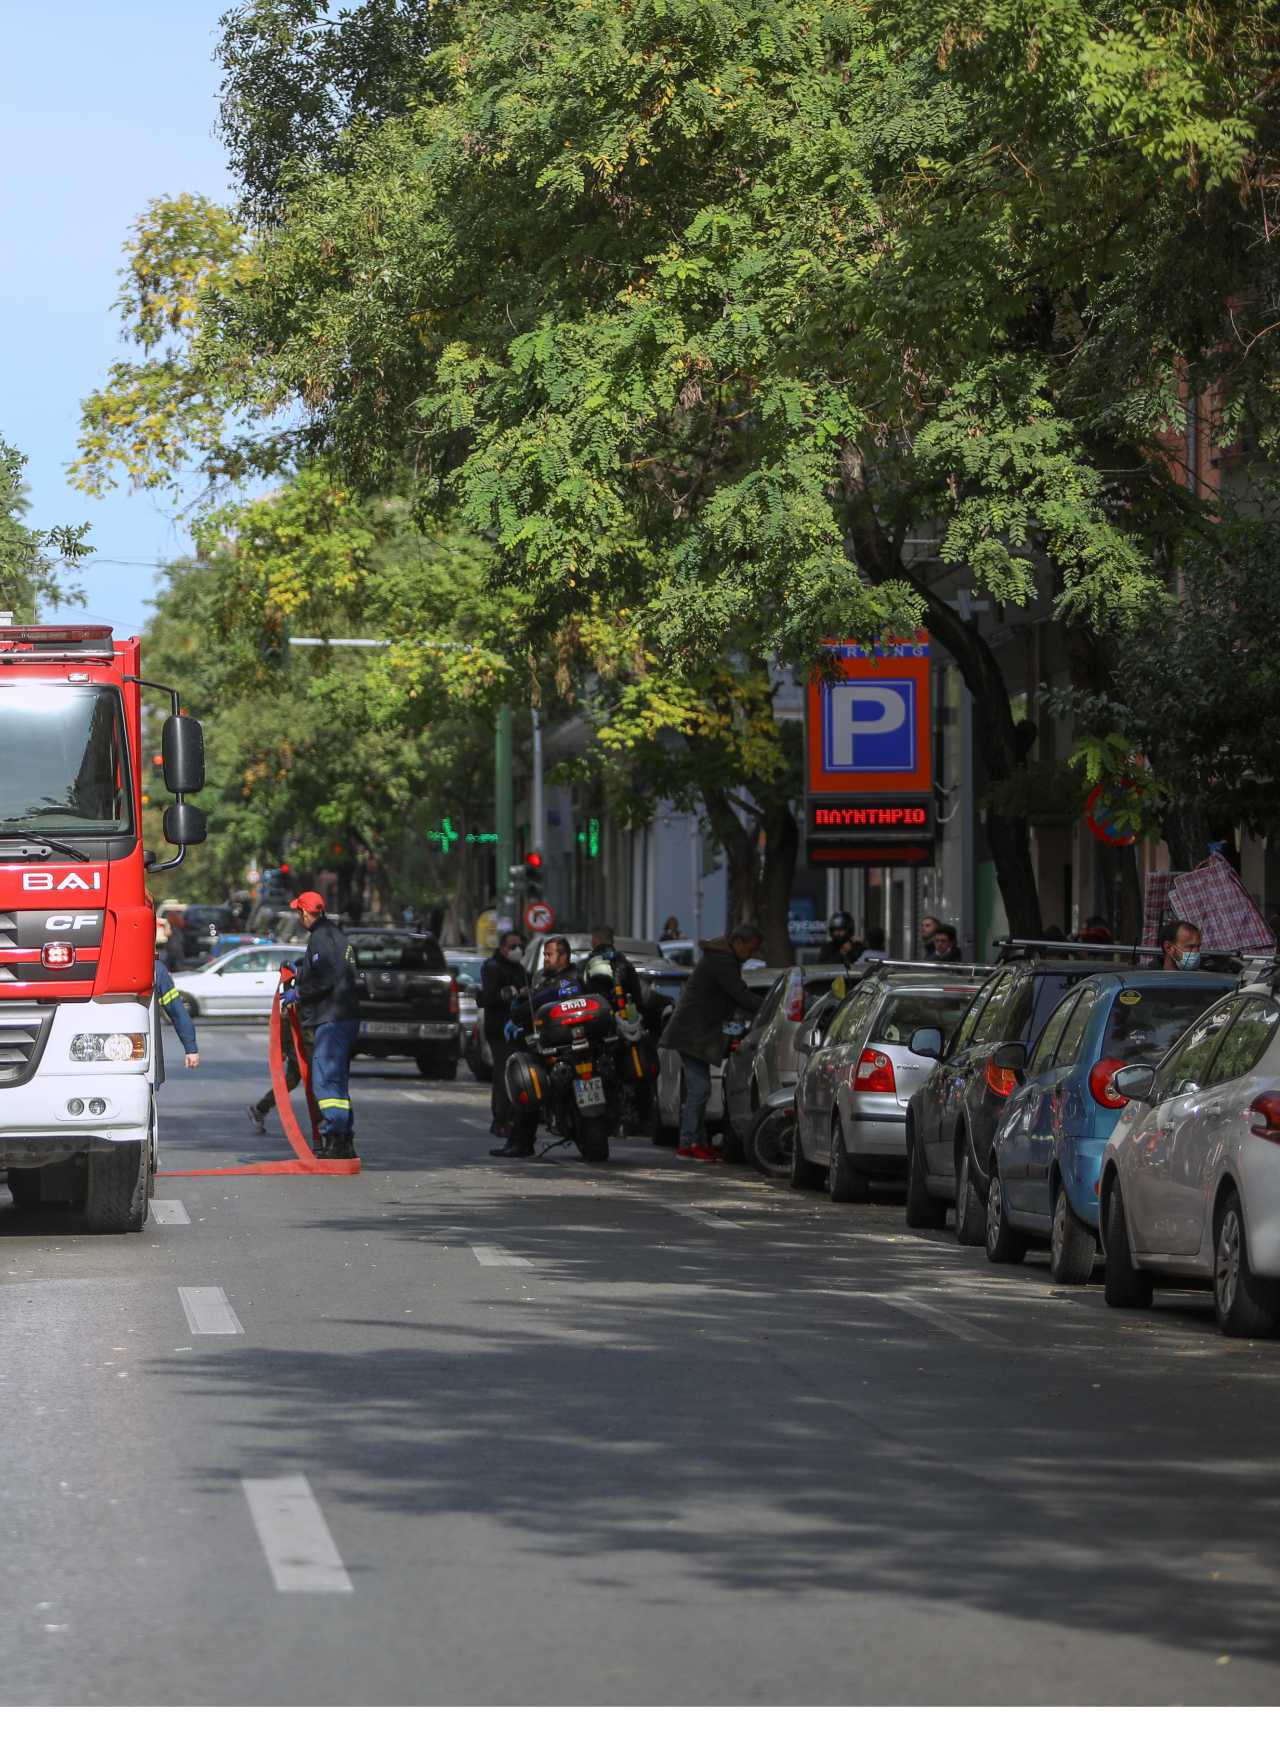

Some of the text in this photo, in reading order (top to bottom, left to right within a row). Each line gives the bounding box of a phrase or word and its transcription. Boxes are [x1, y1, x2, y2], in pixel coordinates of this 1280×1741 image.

[832, 686, 905, 766] P
[815, 808, 926, 826] ΠΛΥΝΤΗΡΙΟ
[23, 872, 101, 891] BAI
[45, 915, 99, 931] CF
